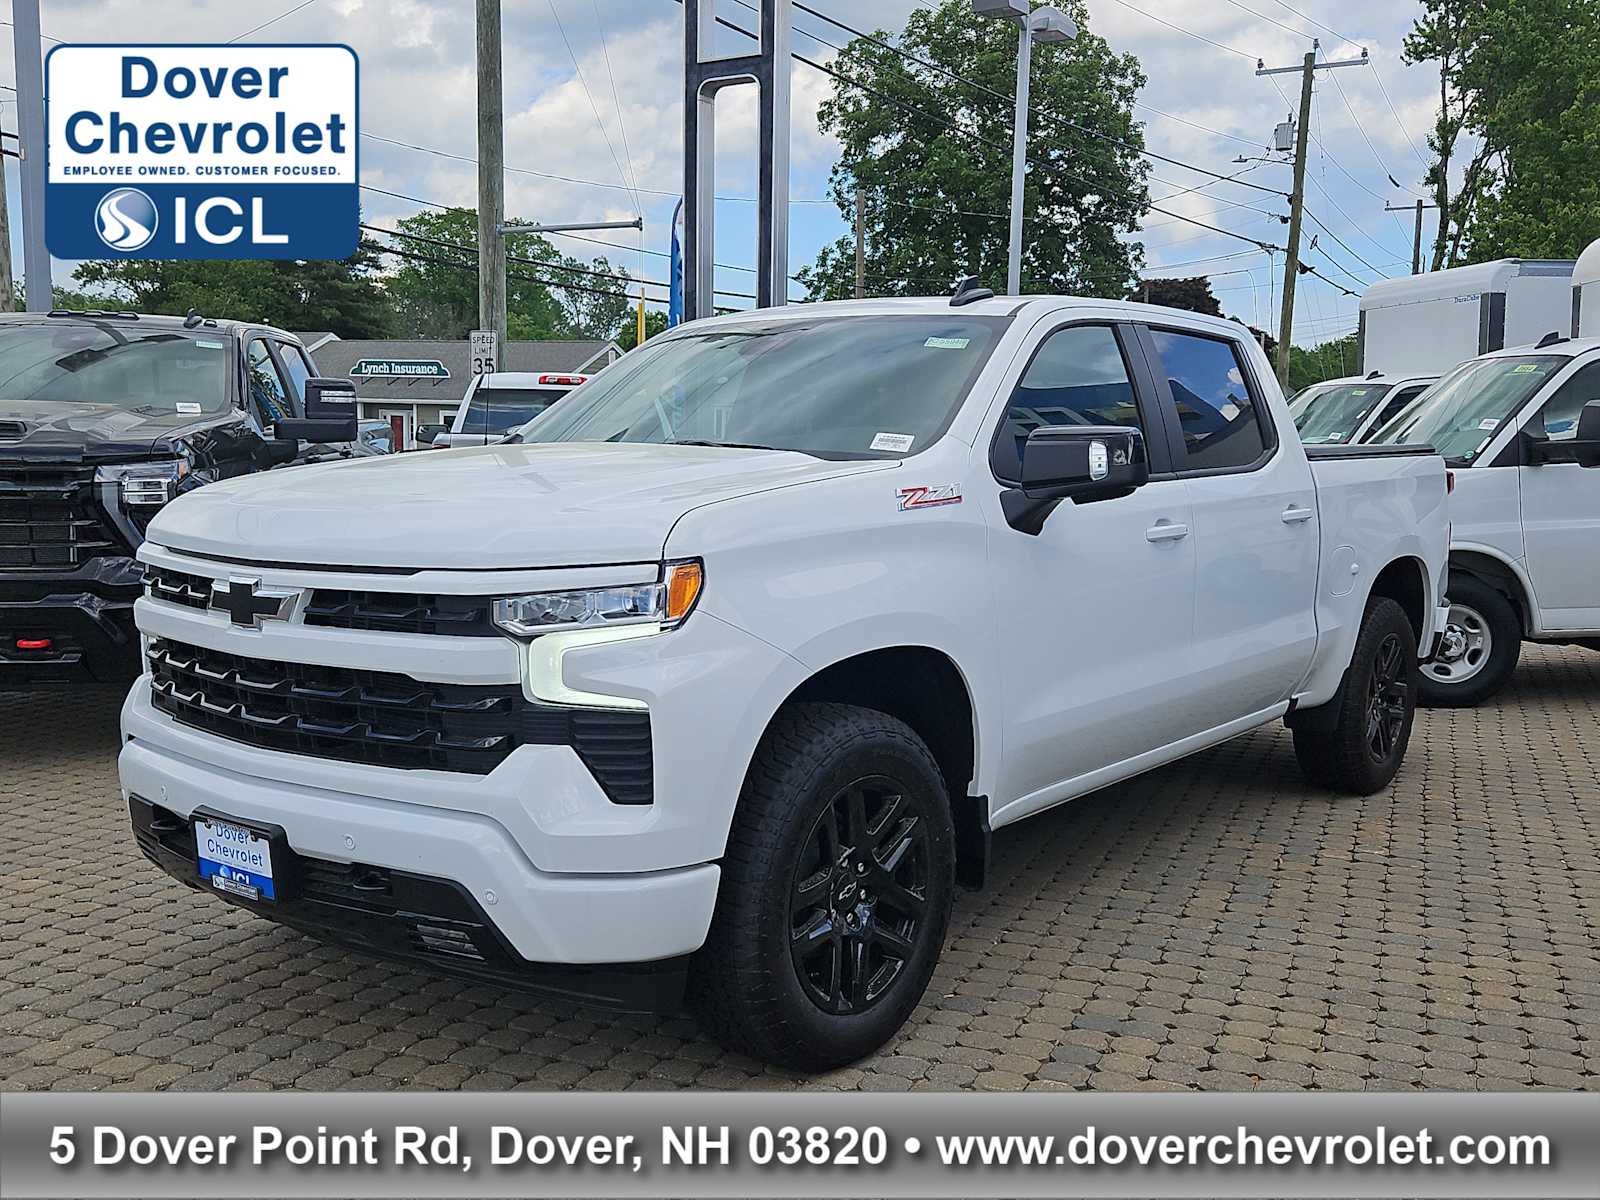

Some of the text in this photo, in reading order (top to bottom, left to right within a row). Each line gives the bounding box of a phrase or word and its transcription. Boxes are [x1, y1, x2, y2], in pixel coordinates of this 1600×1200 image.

[472, 336, 495, 344] SPEED
[474, 346, 492, 355] LIMIT
[361, 362, 438, 376] Lynch Insurance
[473, 357, 495, 375] 35
[895, 481, 964, 512] Z71
[215, 823, 250, 845] Dover
[207, 838, 263, 867] Chevrolet
